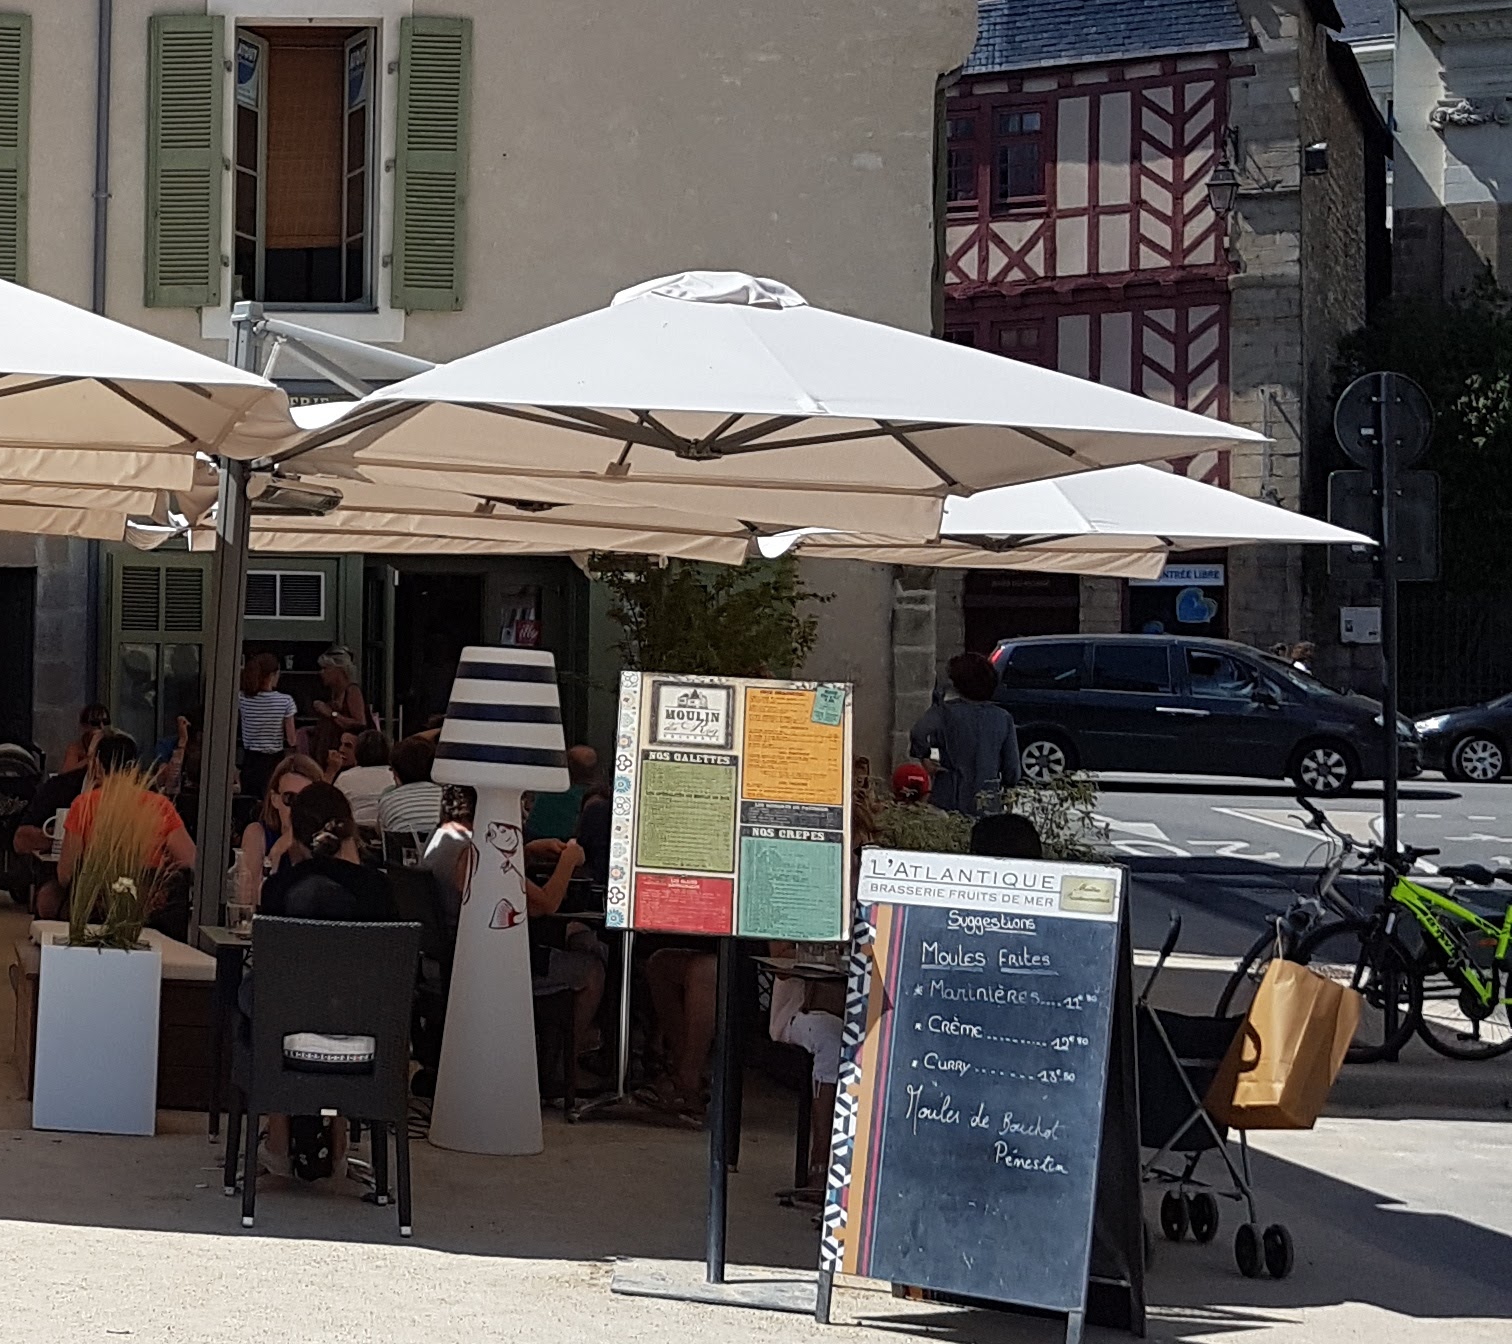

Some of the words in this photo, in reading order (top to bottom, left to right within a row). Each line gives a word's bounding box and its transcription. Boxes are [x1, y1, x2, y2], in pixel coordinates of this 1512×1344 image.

[1163, 569, 1192, 579] NTRÉE
[665, 709, 720, 722] MOULIN
[649, 751, 672, 761] NOS
[674, 752, 731, 765] GALETTES
[752, 827, 775, 838] NOS
[870, 858, 1056, 890] L'ATLANTIQUE
[870, 883, 945, 898] BRASSERIE
[948, 889, 997, 903] FRUITS
[1001, 893, 1020, 904] DE
[1023, 896, 1055, 907] MER
[947, 909, 1036, 935] Suggestions
[905, 1084, 961, 1136] Moules
[970, 1102, 990, 1129] de
[998, 1111, 1065, 1141] Bouchot
